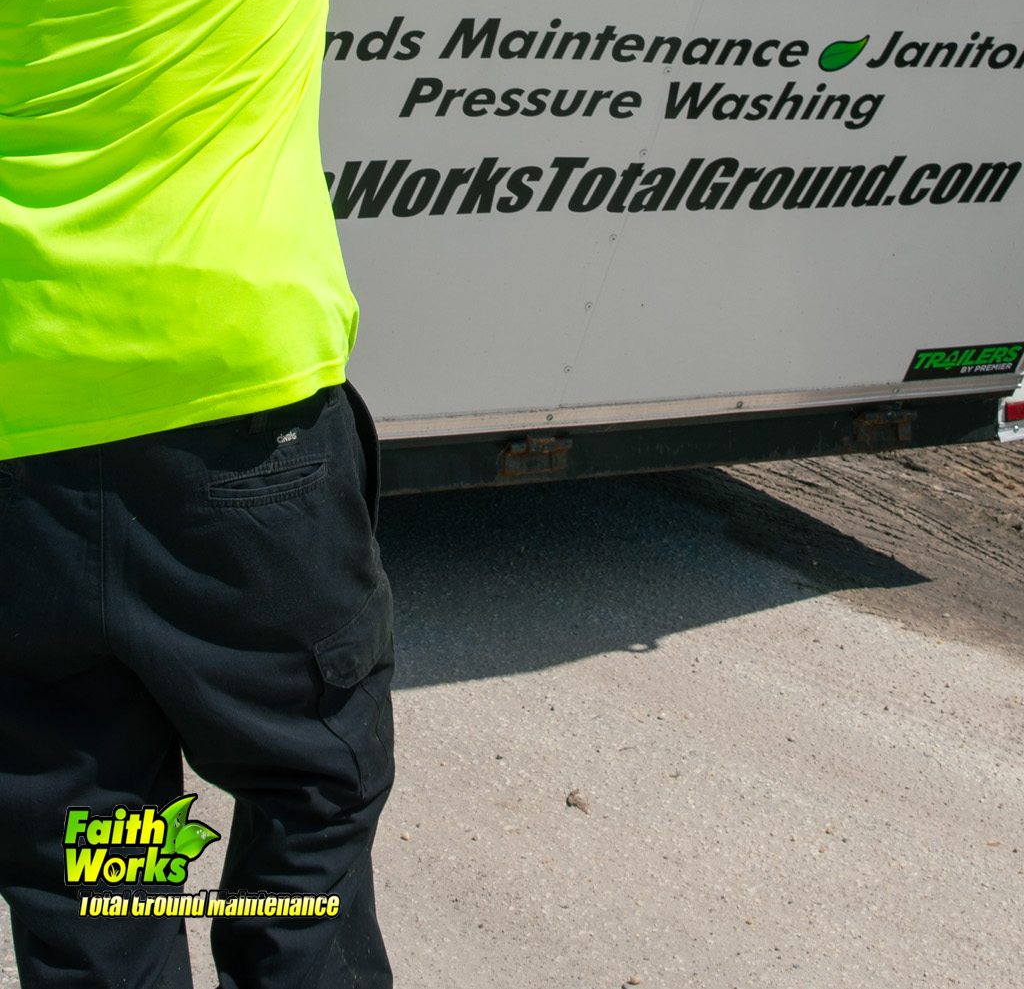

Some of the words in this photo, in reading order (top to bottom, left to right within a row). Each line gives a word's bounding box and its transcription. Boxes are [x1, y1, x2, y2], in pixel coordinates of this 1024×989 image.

[322, 15, 426, 62] nds
[437, 18, 810, 68] Maintenance
[398, 76, 643, 120] Pressure
[663, 82, 885, 131] Washing
[913, 344, 1023, 371] TRAILERS
[959, 365, 973, 374] BY
[974, 362, 1013, 373] PREMIER
